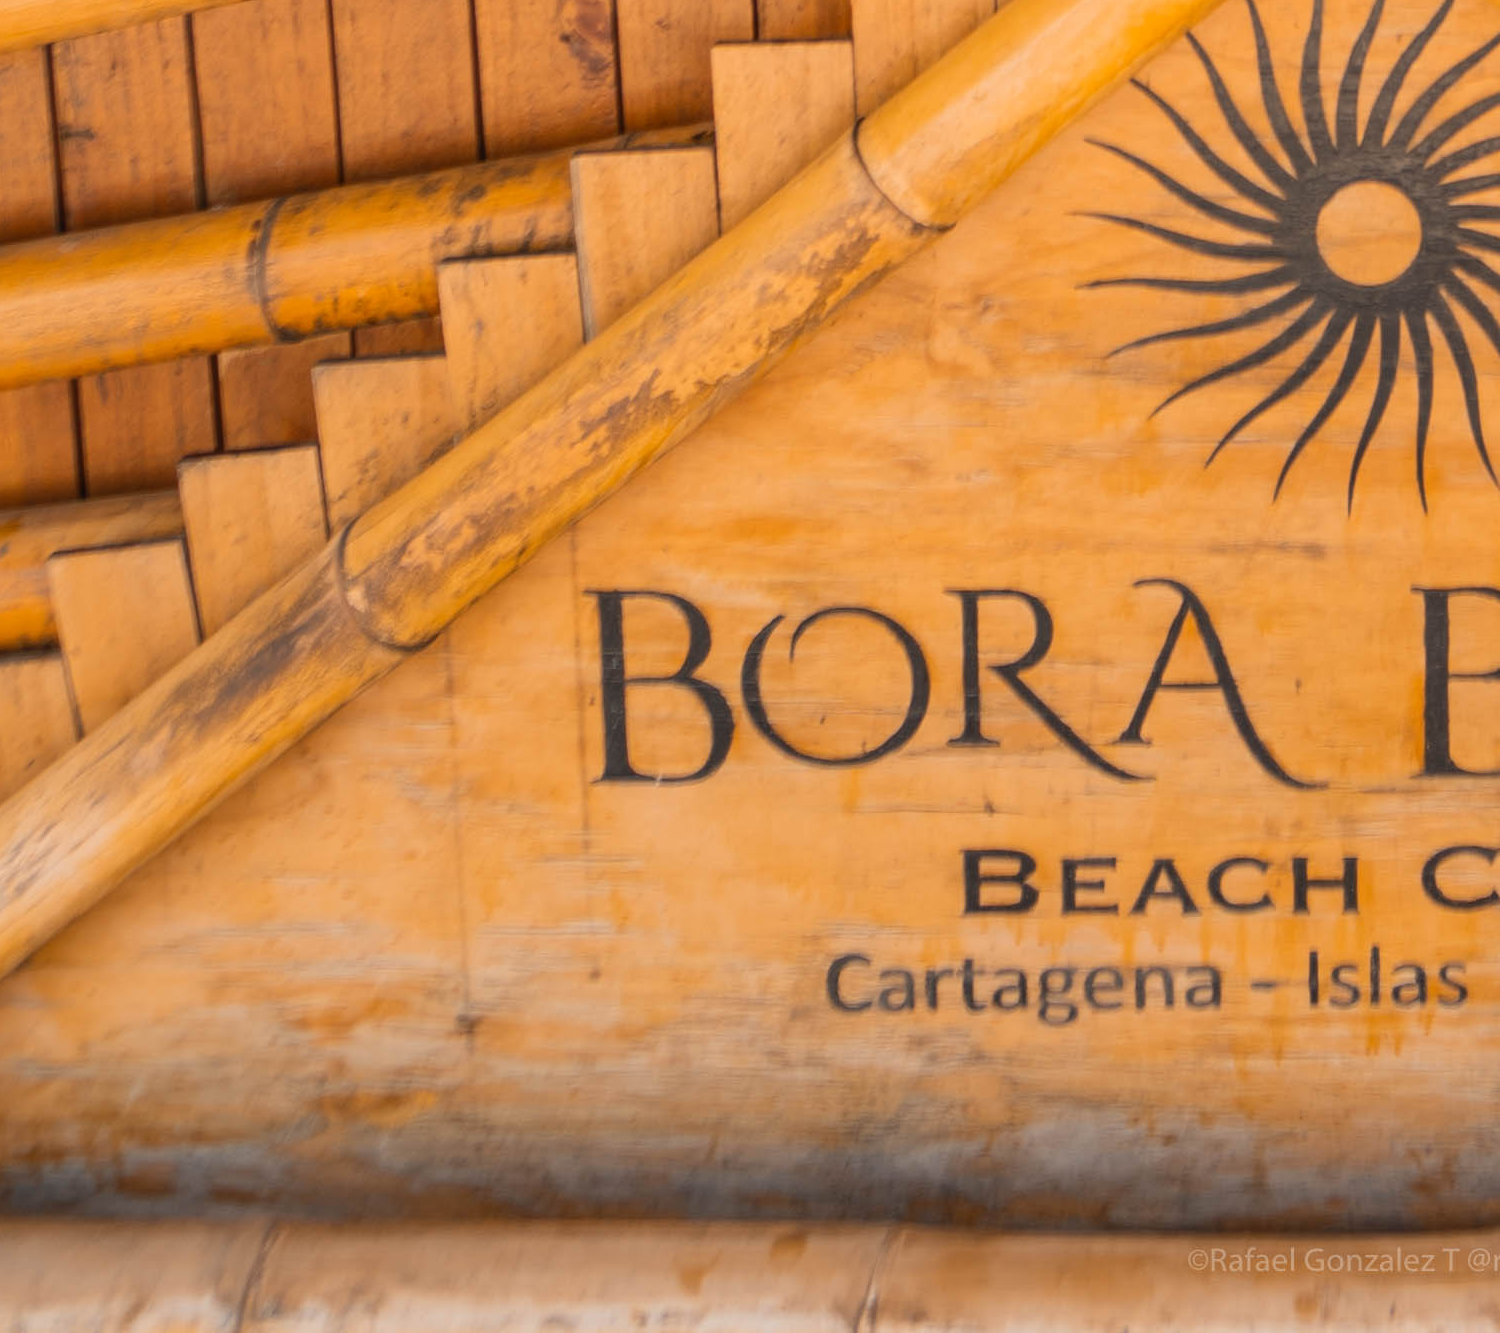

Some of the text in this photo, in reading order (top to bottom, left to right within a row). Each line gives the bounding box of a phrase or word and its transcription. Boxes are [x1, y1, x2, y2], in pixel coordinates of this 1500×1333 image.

[582, 576, 1329, 790] BORA
[961, 848, 1363, 916] BEACH
[825, 950, 1223, 1027] Cartagena
[1308, 945, 1469, 1010] Islas
